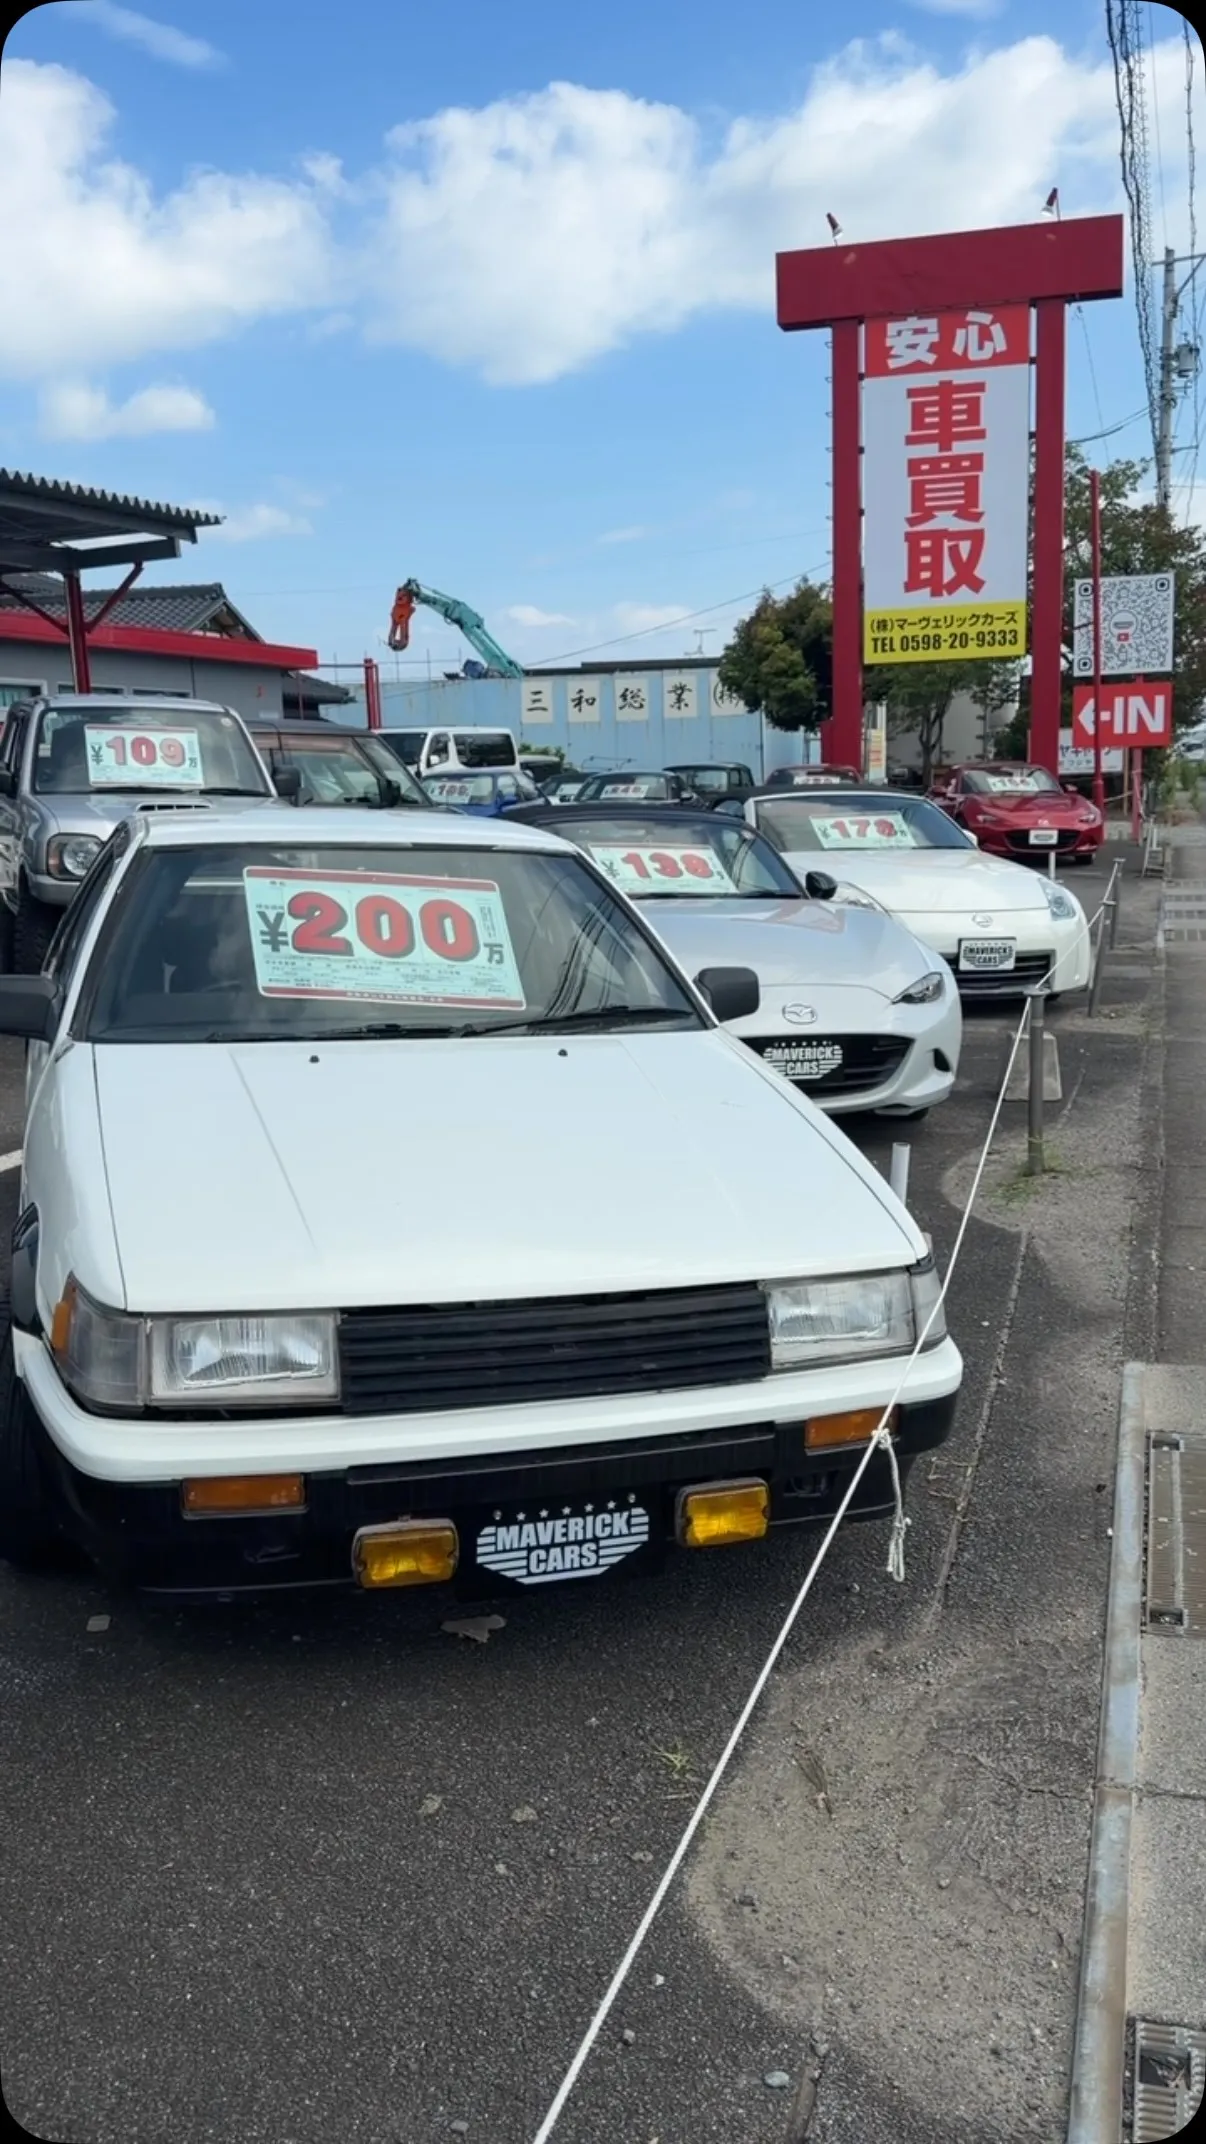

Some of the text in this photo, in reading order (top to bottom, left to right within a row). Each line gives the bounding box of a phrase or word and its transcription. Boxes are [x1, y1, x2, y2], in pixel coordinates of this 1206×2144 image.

[885, 311, 1007, 370] 安心
[904, 379, 986, 598] 車買取
[872, 629, 1018, 653] TEL 0598-20-9333
[1113, 694, 1165, 735] IN
[772, 1046, 834, 1061] MAVERICK
[786, 1061, 818, 1075] CARS
[496, 1511, 630, 1551] MAVERICK
[529, 1542, 598, 1574] CARS
